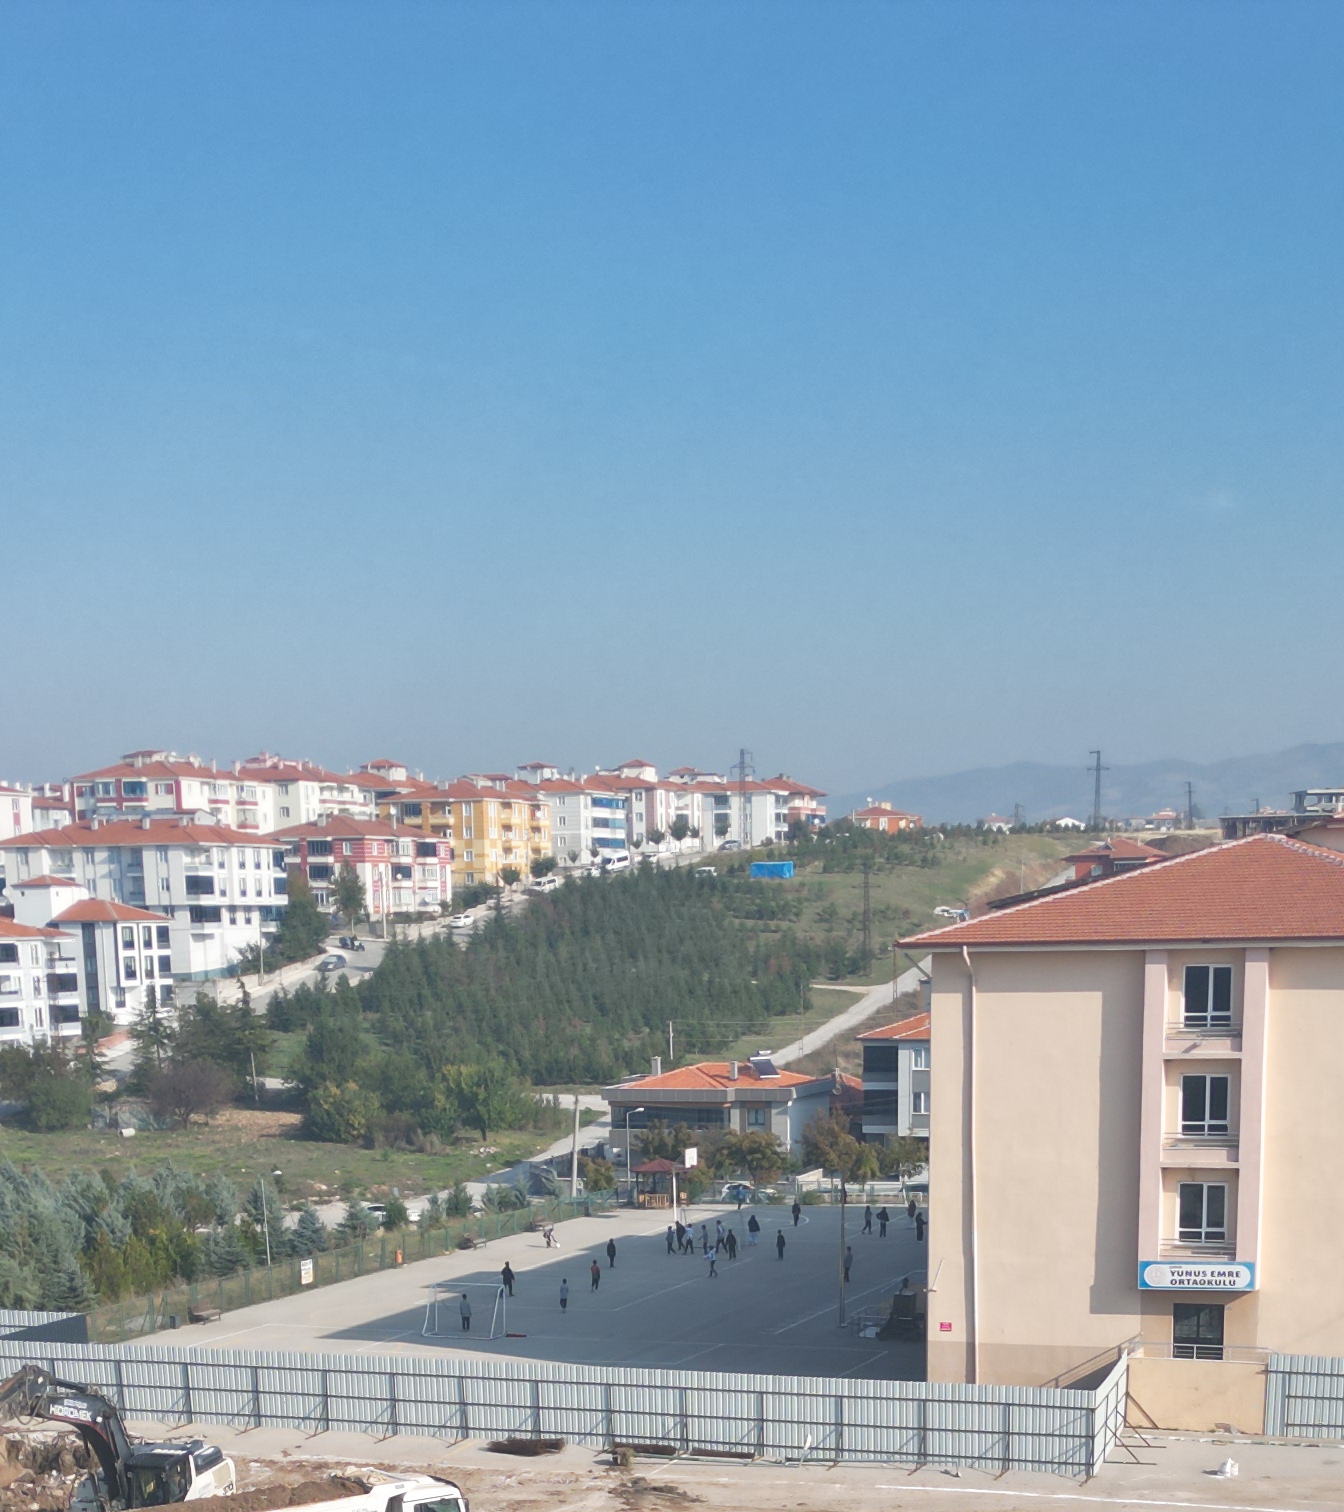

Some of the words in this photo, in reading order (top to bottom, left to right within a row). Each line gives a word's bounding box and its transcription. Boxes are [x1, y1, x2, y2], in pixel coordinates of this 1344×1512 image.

[1169, 1269, 1208, 1278] YUNUS
[1210, 1270, 1241, 1278] EMRE
[1169, 1278, 1236, 1287] ORTAOKULU
